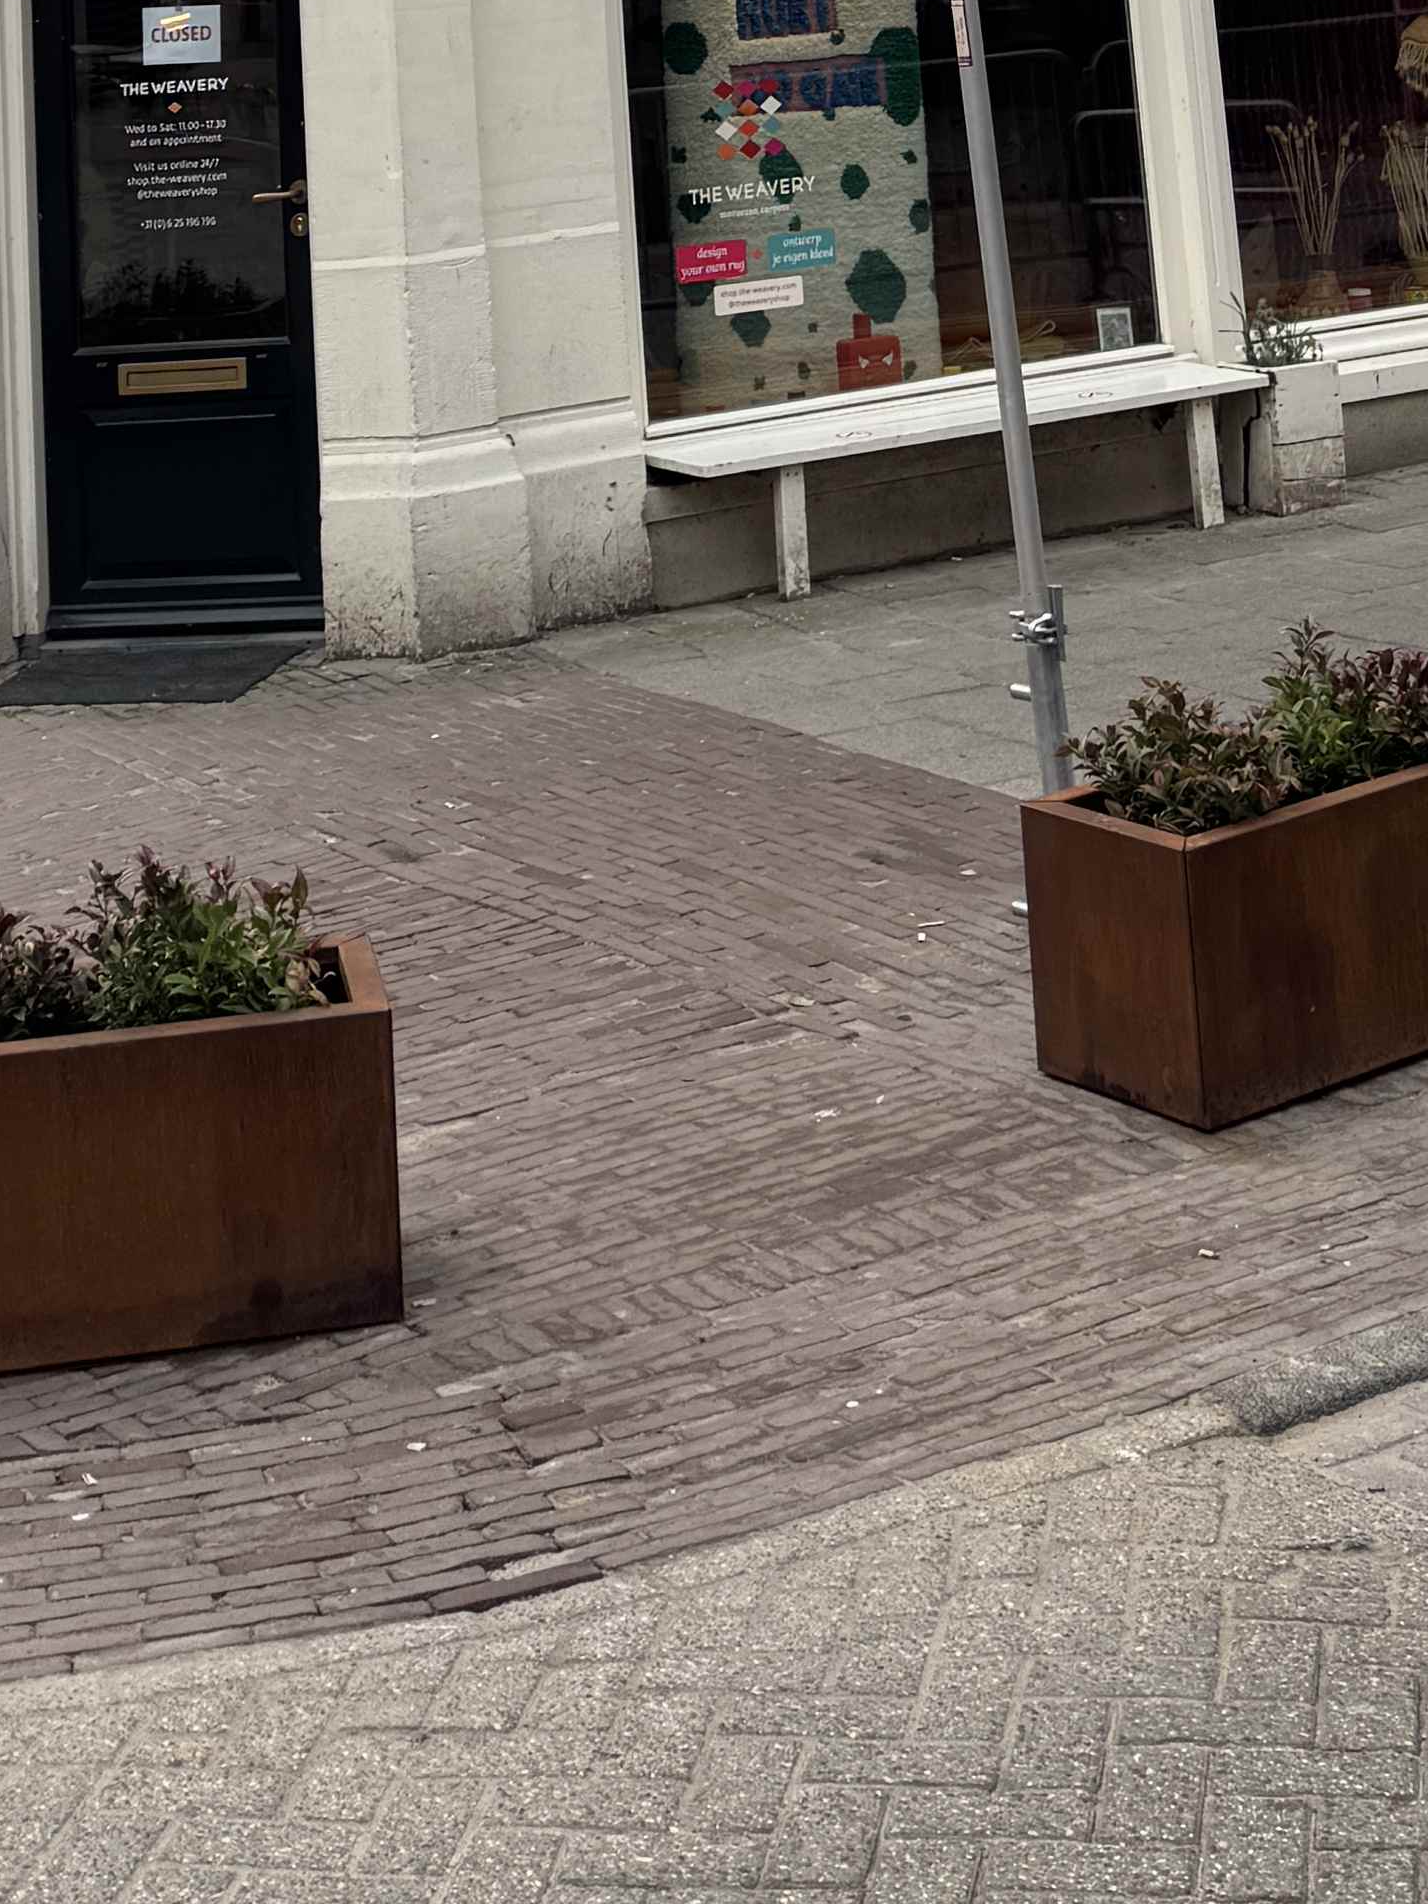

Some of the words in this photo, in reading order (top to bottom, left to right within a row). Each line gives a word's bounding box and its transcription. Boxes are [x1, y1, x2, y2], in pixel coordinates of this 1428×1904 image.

[151, 25, 212, 43] CLOSED
[120, 82, 149, 96] THE
[151, 77, 229, 93] WEAVERY
[147, 124, 157, 133] to
[130, 137, 147, 147] and
[133, 162, 155, 172] Visit
[157, 162, 168, 171] us
[169, 160, 199, 170] online
[689, 187, 722, 205] THE
[725, 176, 815, 200] WEAVERY
[783, 235, 822, 247] ontwerp
[696, 246, 727, 260] design
[681, 266, 704, 281] your
[706, 263, 726, 274] own
[729, 260, 745, 273] rug
